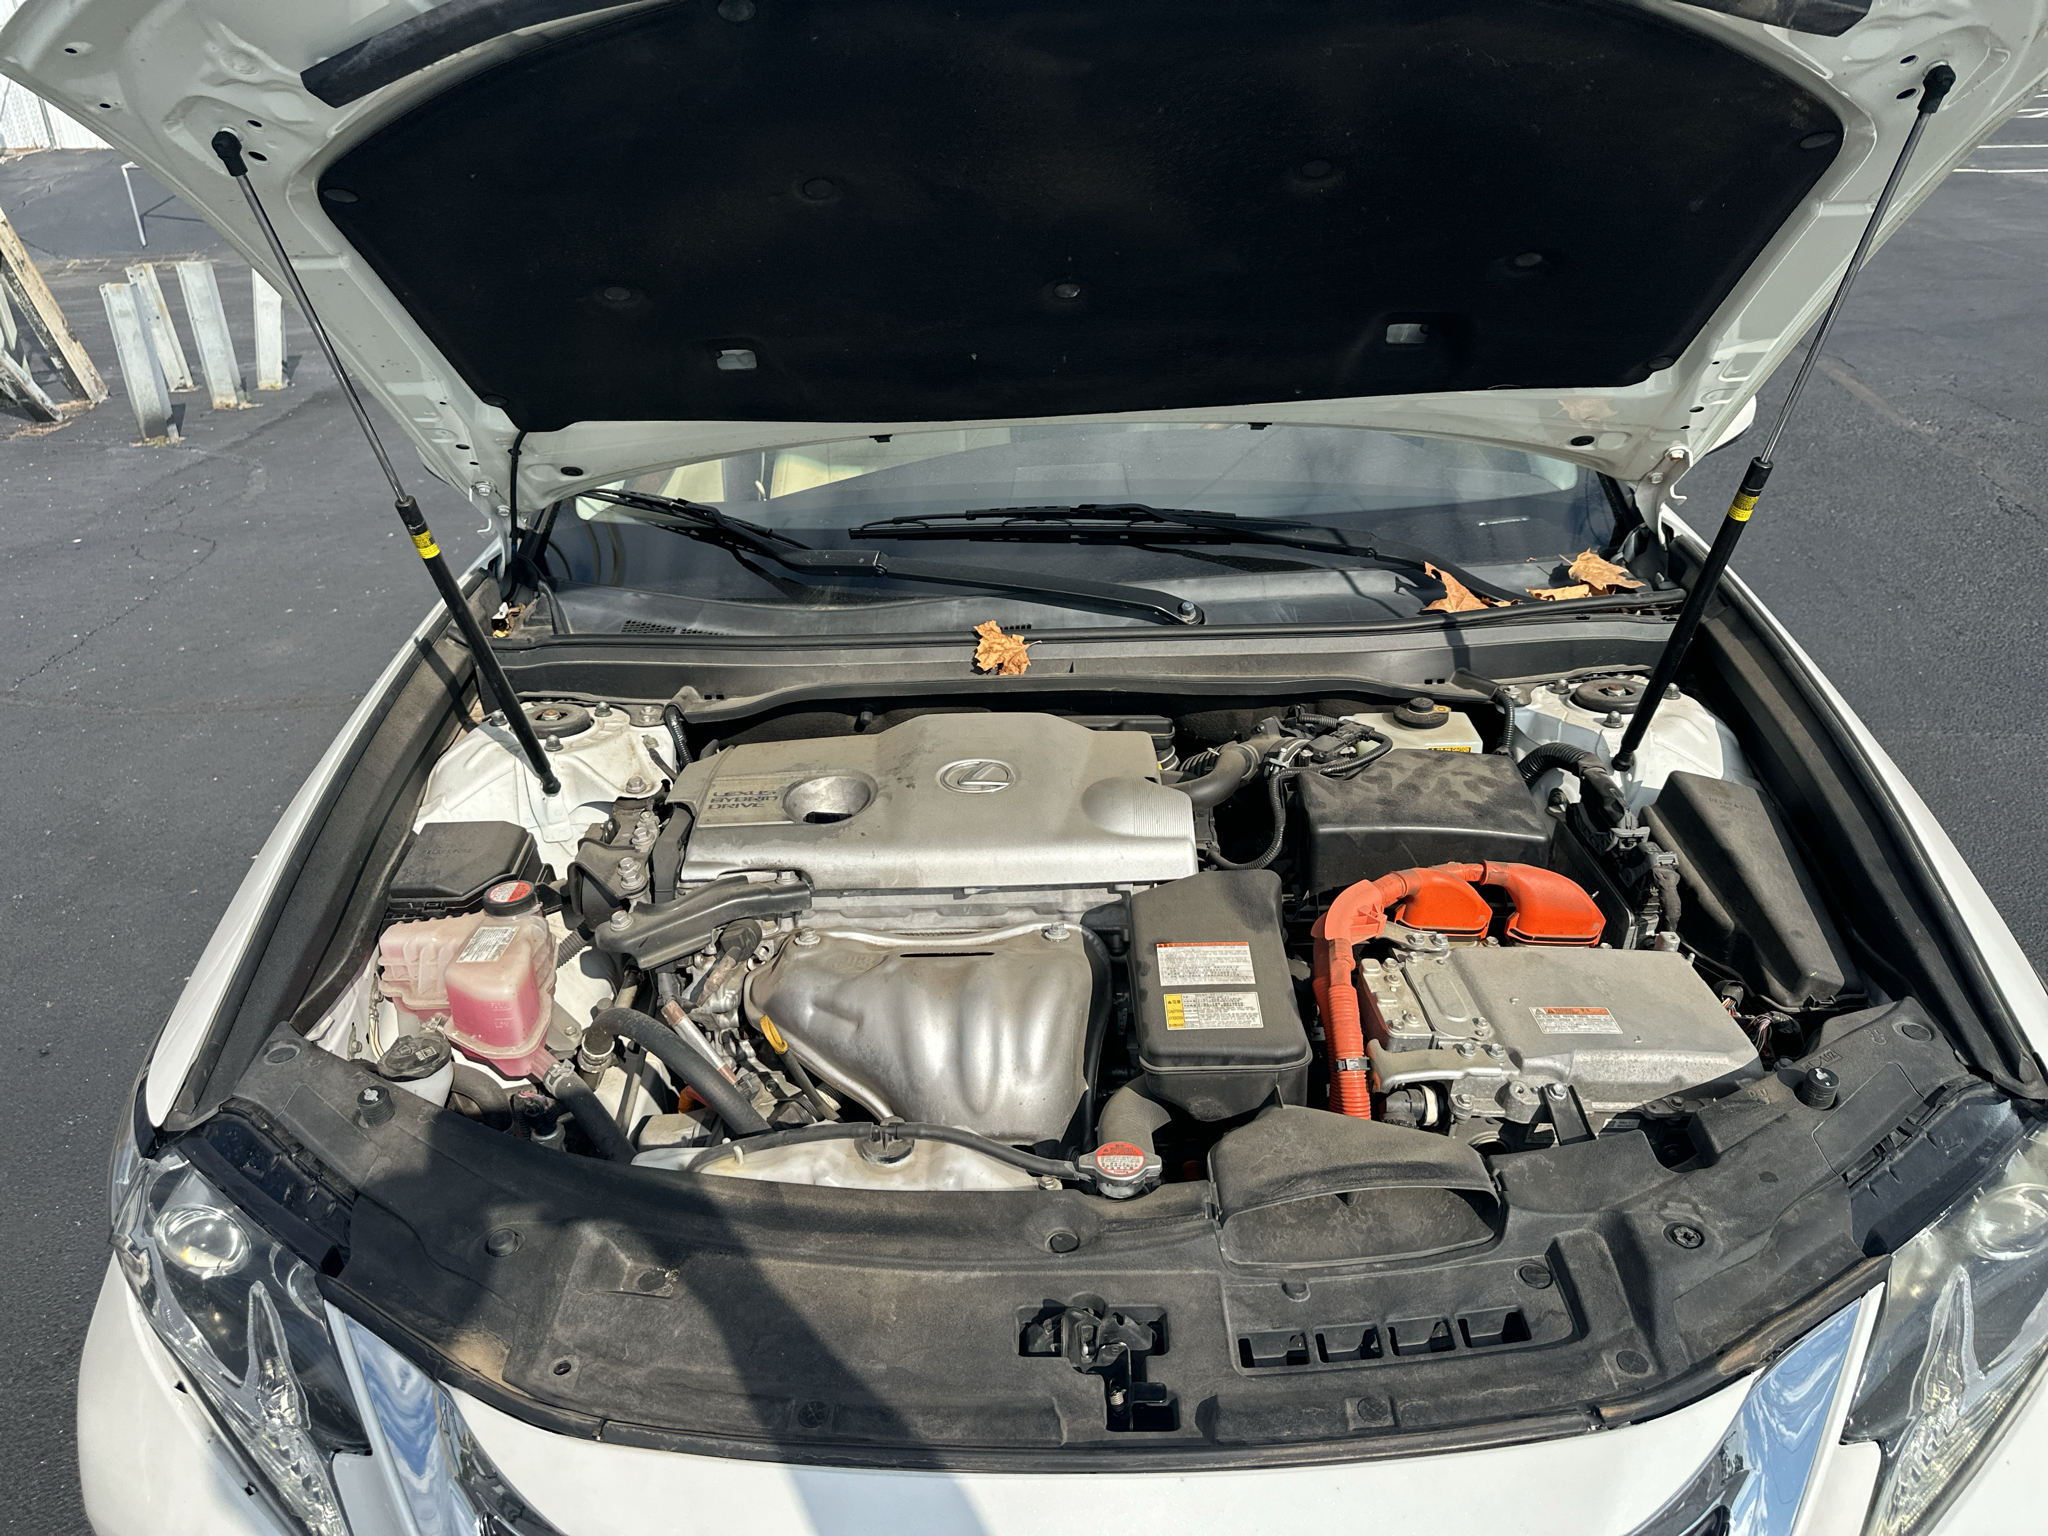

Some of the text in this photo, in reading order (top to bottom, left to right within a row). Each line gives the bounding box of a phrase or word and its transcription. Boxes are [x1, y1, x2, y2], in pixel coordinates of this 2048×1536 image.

[713, 789, 777, 797] LEXUS
[710, 795, 779, 804] HYBRID
[707, 802, 766, 810] DRIVE
